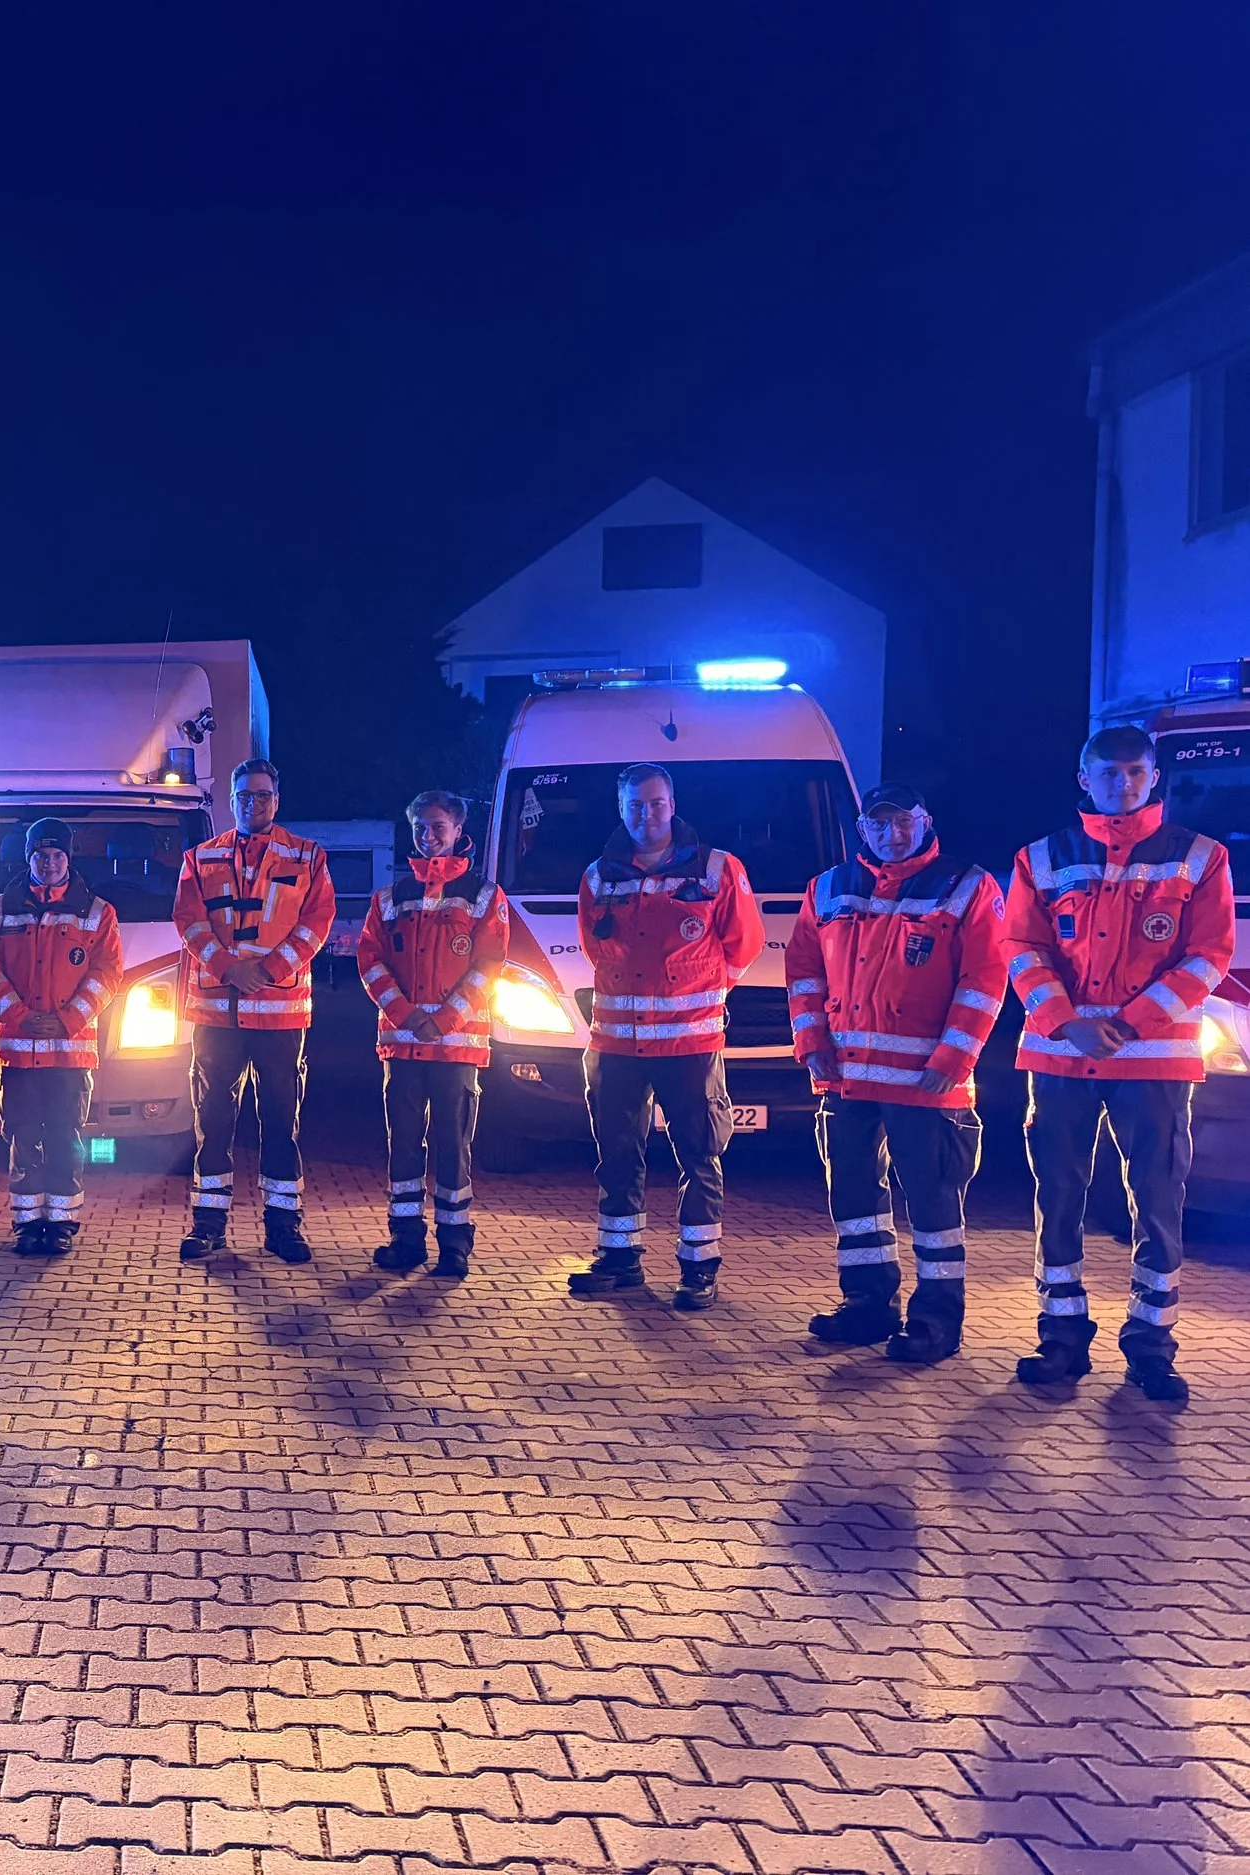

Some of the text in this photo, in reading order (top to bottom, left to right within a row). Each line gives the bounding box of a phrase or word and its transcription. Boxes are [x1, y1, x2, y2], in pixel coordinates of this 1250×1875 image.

[1175, 747, 1241, 760] 90-19-1
[532, 776, 568, 786] 5/59-1
[733, 1108, 757, 1126] 22
